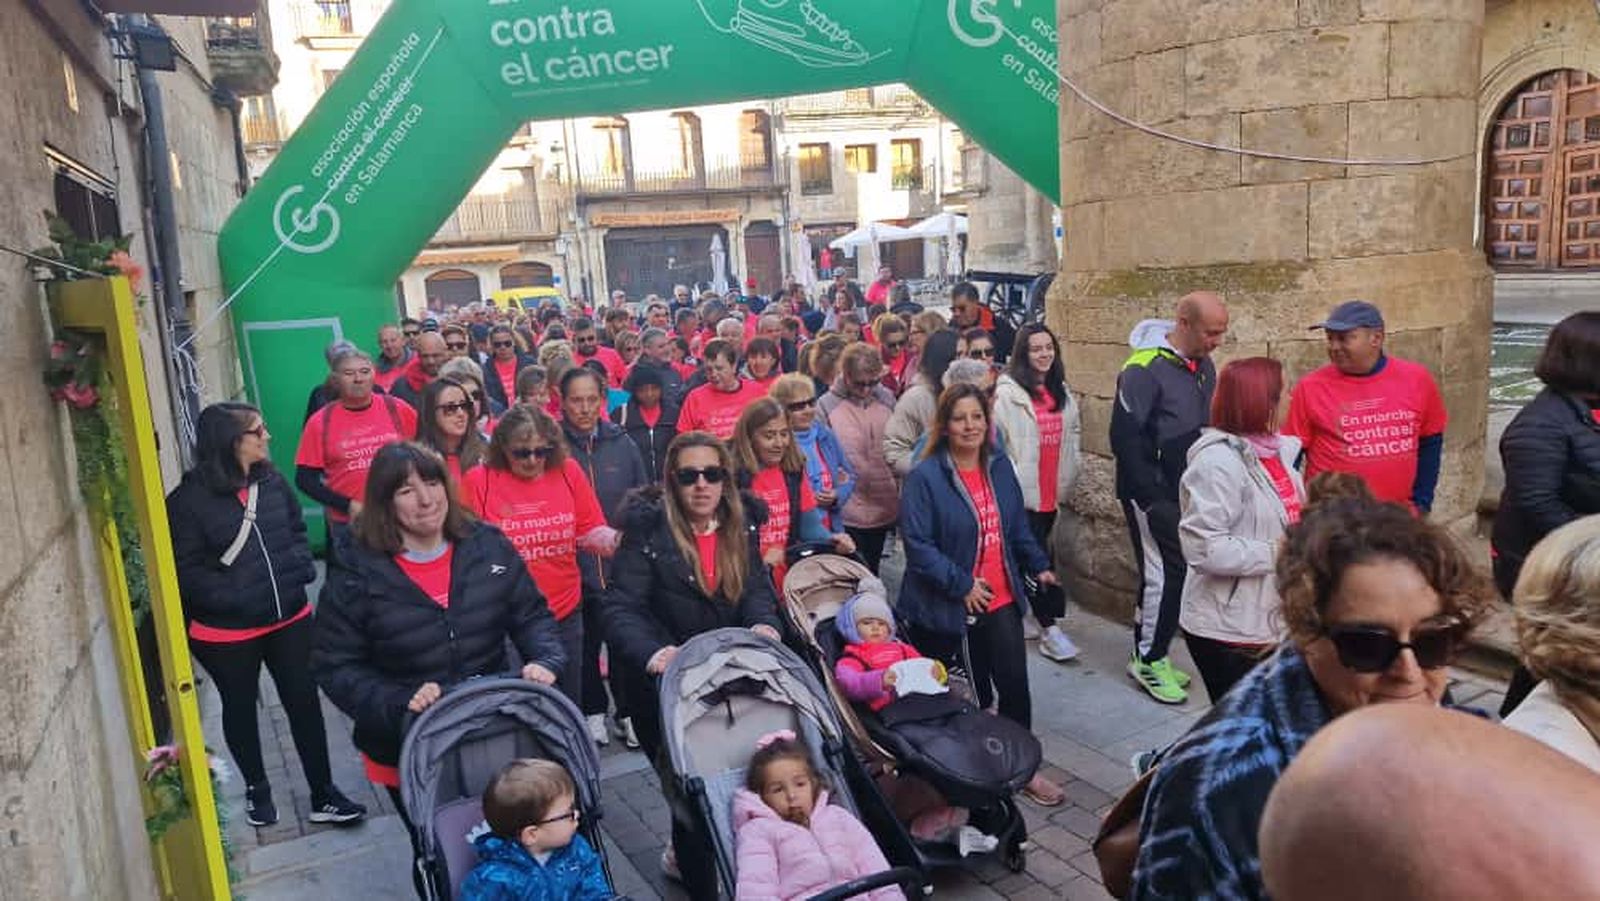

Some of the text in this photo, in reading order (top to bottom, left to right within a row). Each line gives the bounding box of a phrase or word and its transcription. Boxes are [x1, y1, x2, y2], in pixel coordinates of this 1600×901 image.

[490, 5, 615, 46] contra
[501, 44, 674, 85] el cáncer
[1002, 53, 1025, 75] en
[327, 143, 365, 190] contra
[344, 102, 424, 205] en Salamanca
[1341, 409, 1416, 427] En marcha
[1343, 425, 1400, 442] contra
[502, 518, 521, 532] En
